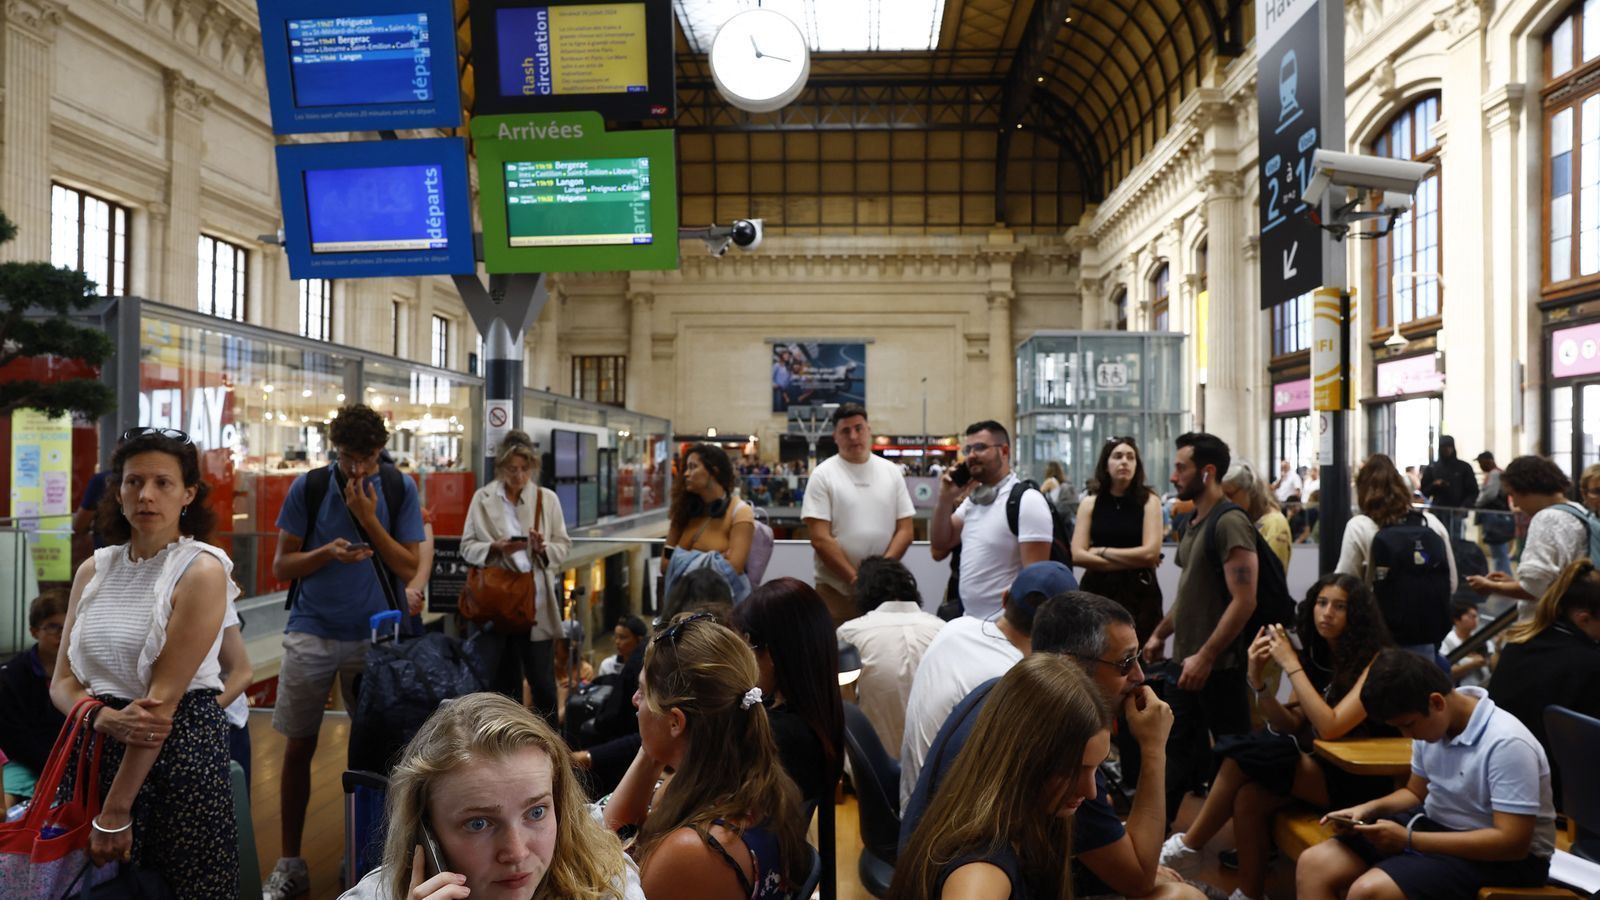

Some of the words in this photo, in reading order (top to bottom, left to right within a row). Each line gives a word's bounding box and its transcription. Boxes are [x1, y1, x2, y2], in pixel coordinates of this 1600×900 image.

[335, 17, 373, 29] Périgueux
[337, 35, 370, 49] Bergerac
[320, 45, 347, 54] Libourne
[534, 10, 551, 96] circulation
[521, 57, 536, 96] flash
[498, 120, 584, 141] Arrivées
[555, 160, 588, 173] Bergerac
[556, 178, 585, 188] Langon
[564, 186, 587, 195] Langon
[1268, 177, 1279, 221] 2
[1286, 162, 1293, 183] à
[424, 167, 445, 241] départs
[556, 193, 588, 204] Périgueux
